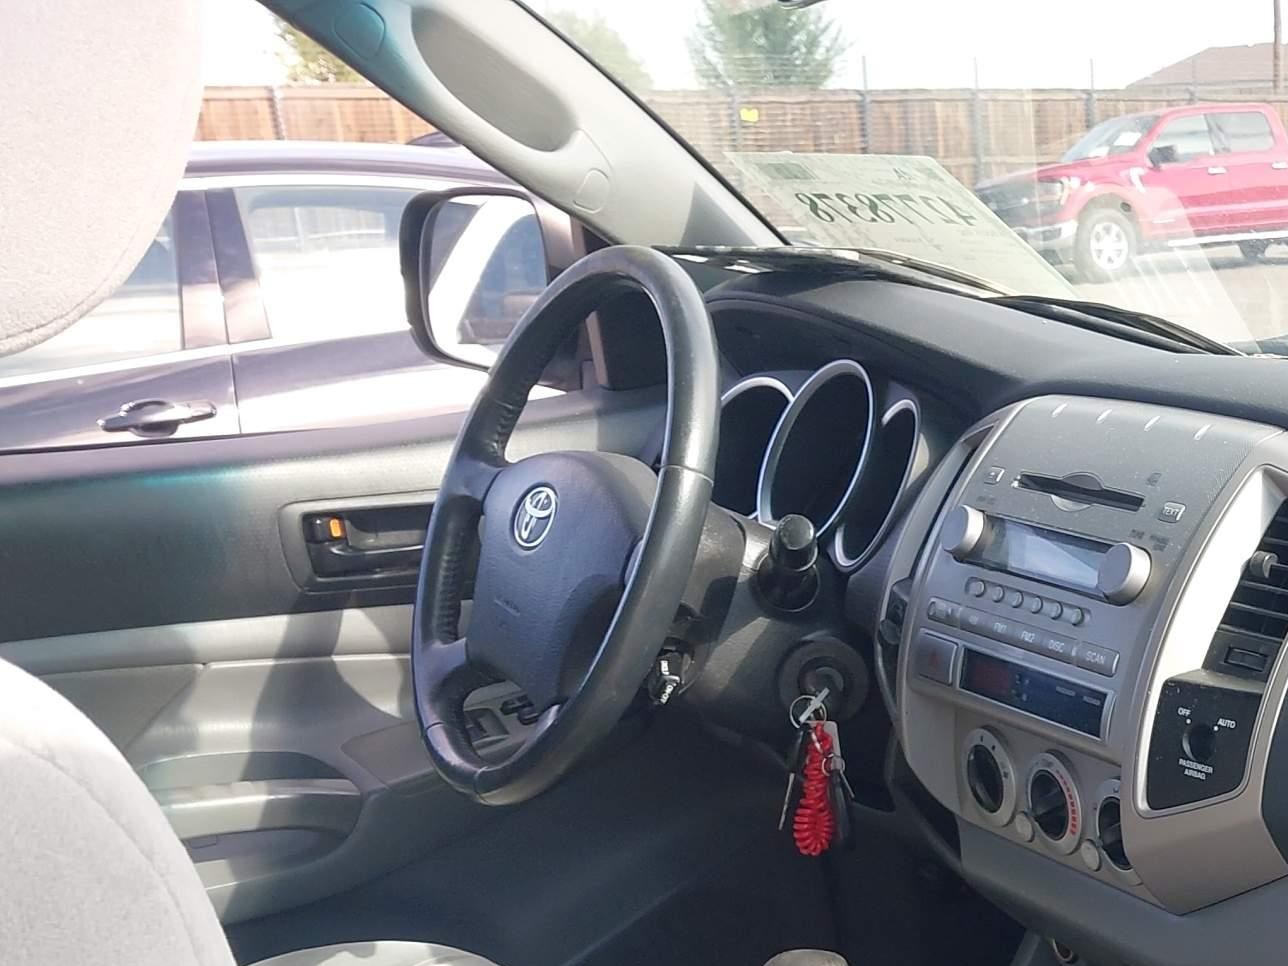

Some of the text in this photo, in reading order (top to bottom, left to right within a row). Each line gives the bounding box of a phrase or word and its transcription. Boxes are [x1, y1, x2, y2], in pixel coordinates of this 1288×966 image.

[1047, 638, 1065, 653] DISC
[1085, 651, 1106, 665] SCAN
[1177, 706, 1192, 717] OFF
[1217, 717, 1236, 730] AUTO
[1178, 758, 1214, 774] PASSENGER
[1184, 768, 1206, 781] AIRBAG
